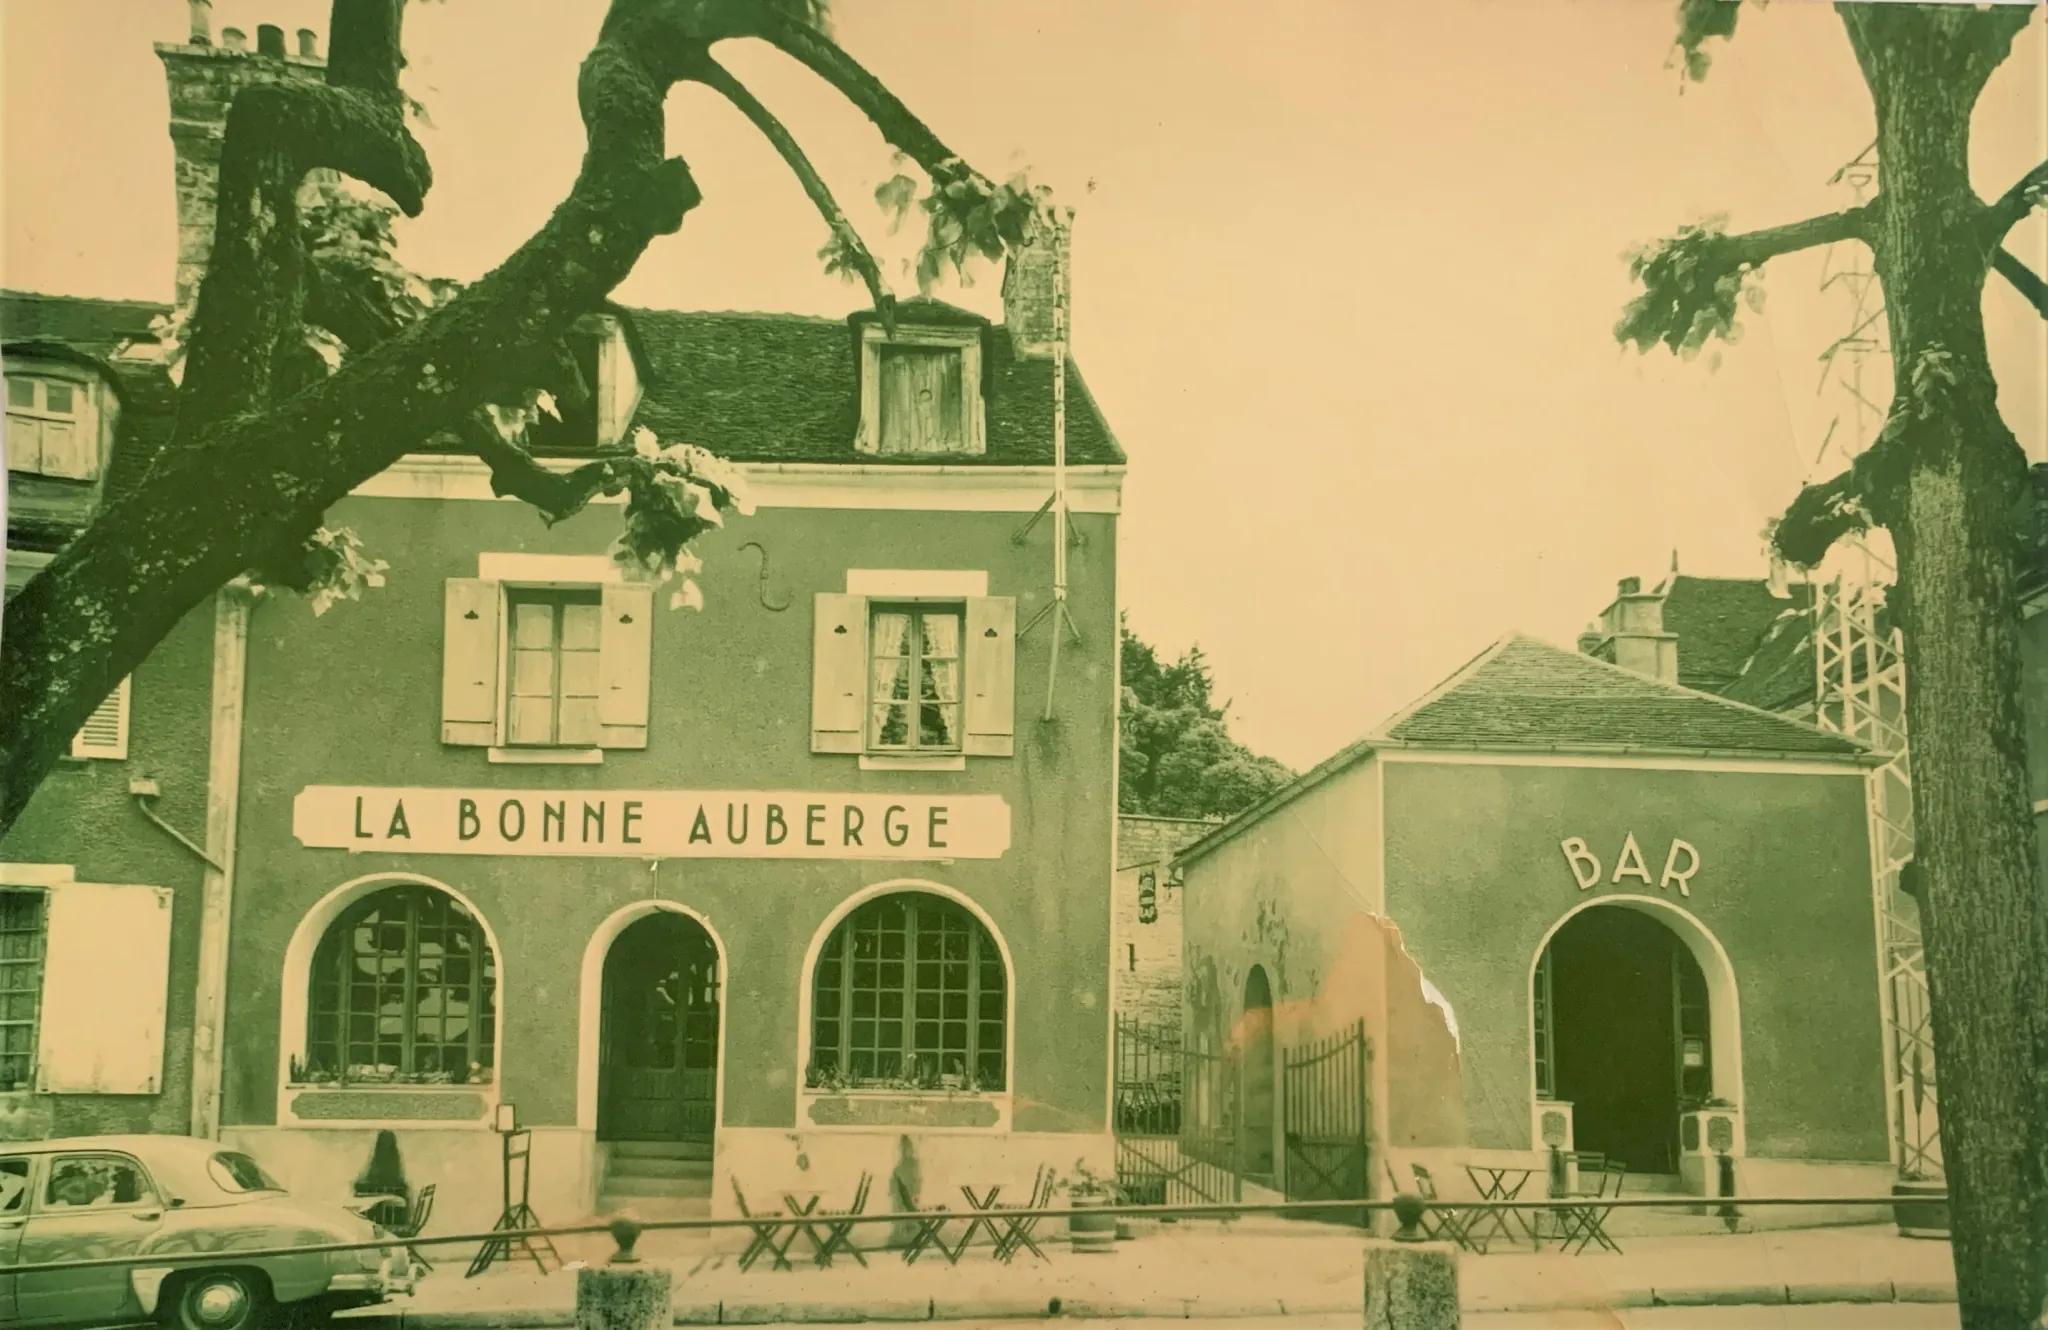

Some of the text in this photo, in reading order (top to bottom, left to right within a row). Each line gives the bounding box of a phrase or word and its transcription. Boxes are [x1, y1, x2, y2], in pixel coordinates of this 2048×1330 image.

[354, 796, 949, 848] LA BONNE AUBERGE
[1560, 830, 1701, 897] BAR
